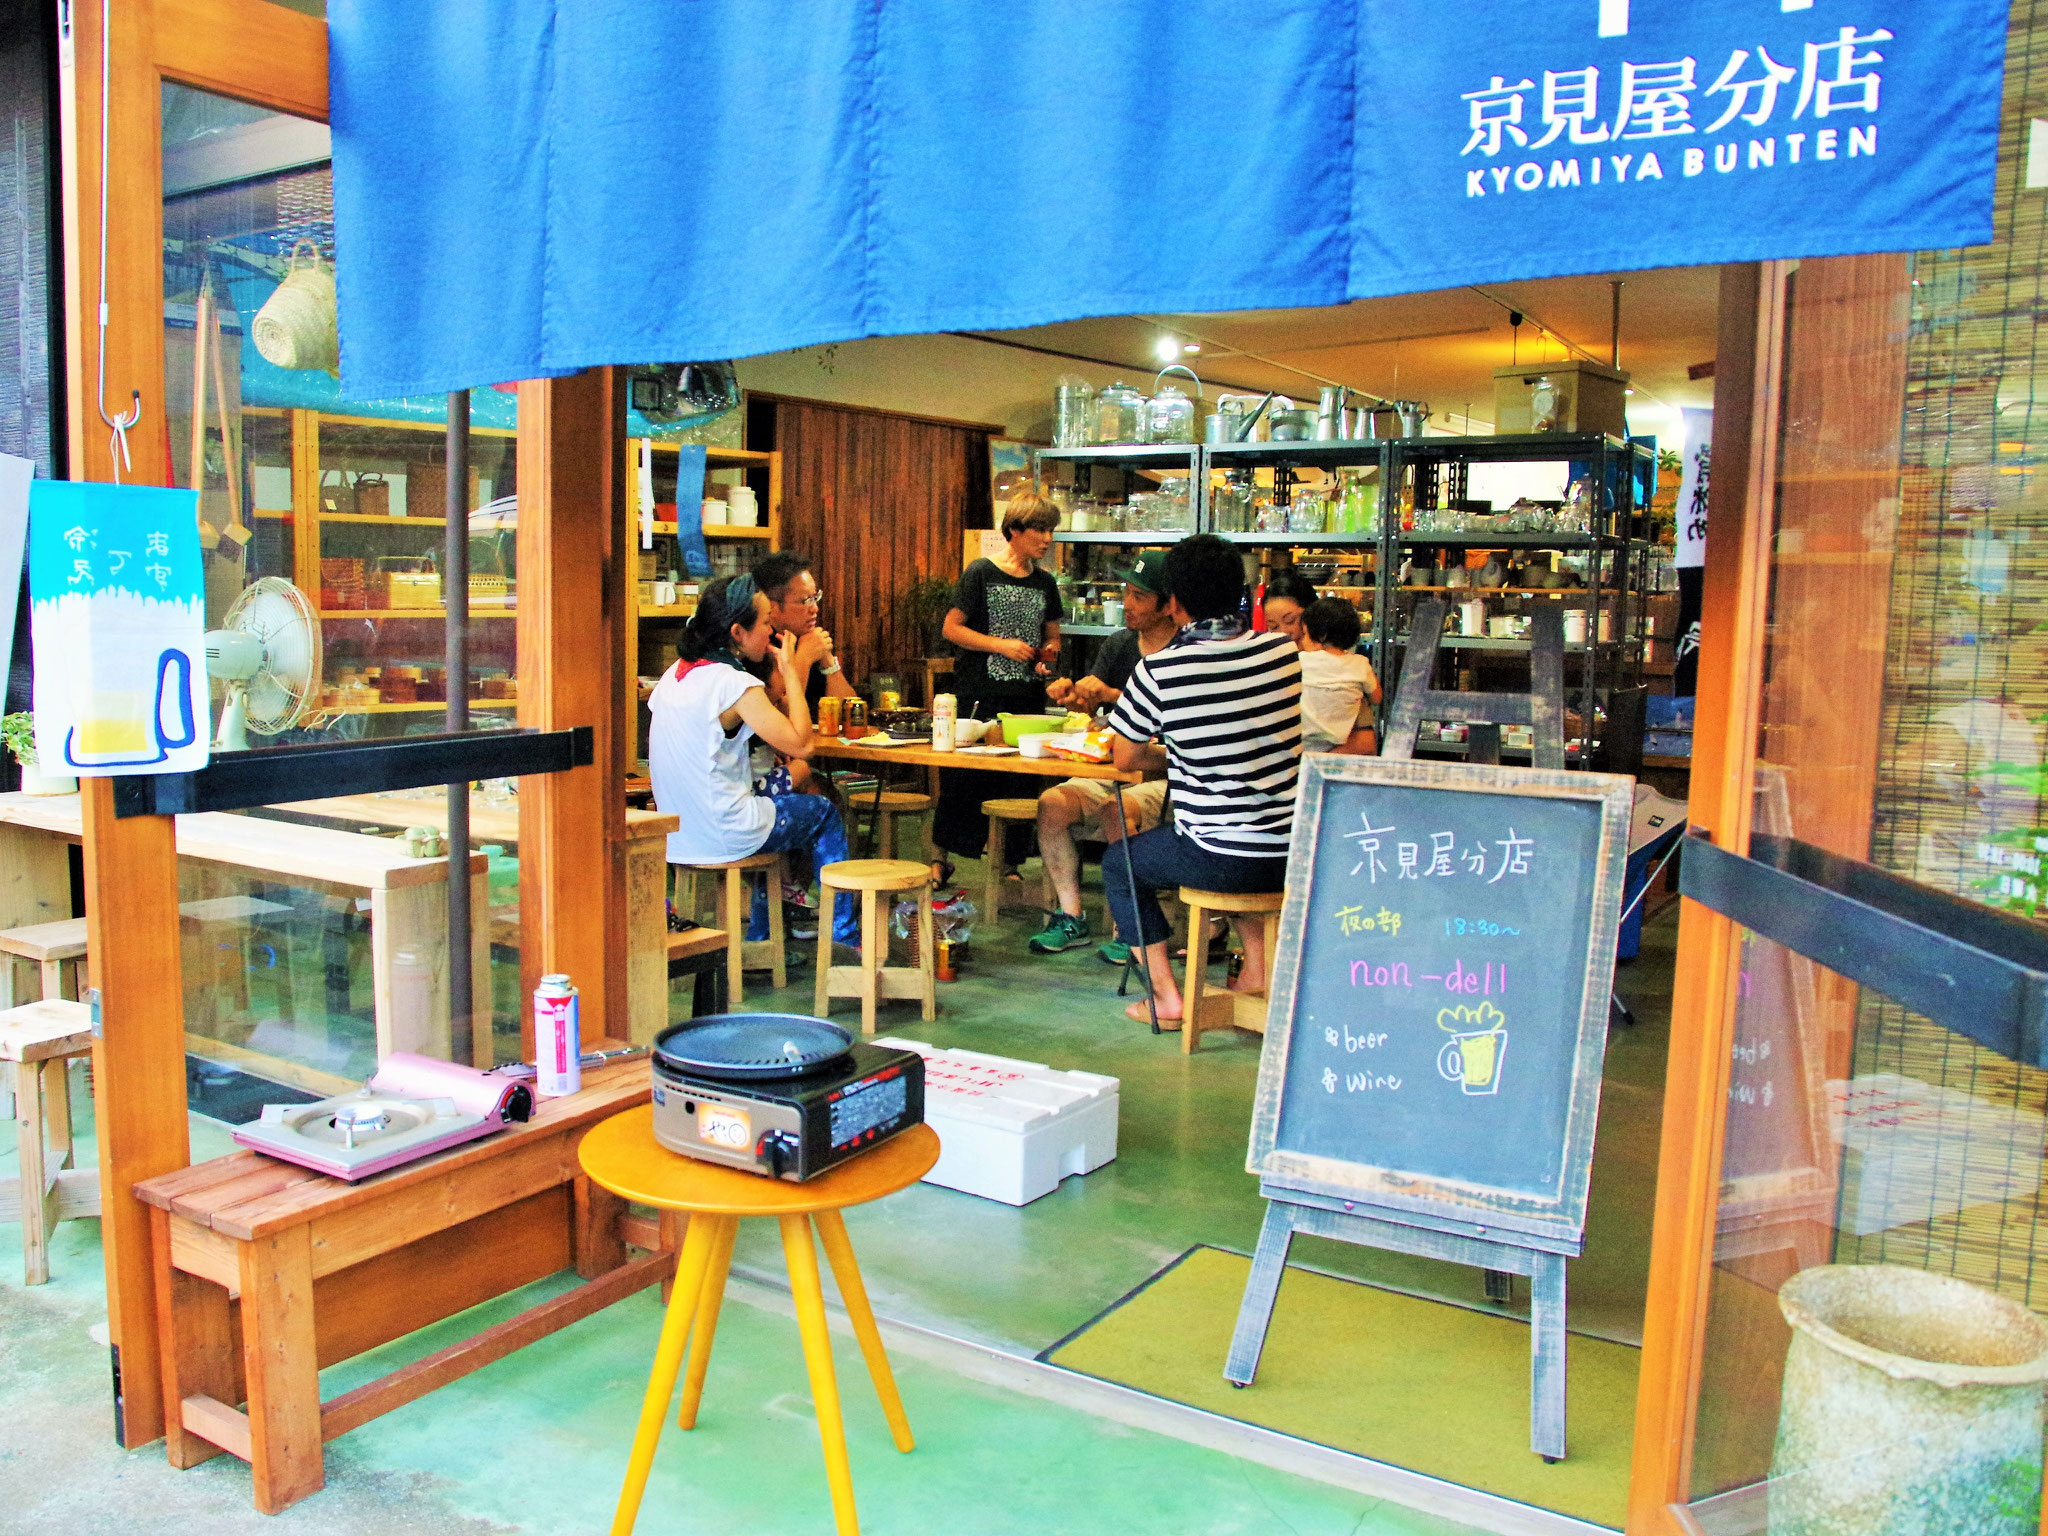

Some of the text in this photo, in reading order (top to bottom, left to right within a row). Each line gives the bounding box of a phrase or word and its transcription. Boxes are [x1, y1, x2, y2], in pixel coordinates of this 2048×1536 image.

[1460, 26, 1894, 156] 京見屋分店
[1466, 124, 1877, 198] KYOMIYA BUNTEN
[1342, 811, 1535, 884] 京見屋分店
[1334, 904, 1402, 937] 夜の部
[1343, 1024, 1388, 1054] beer
